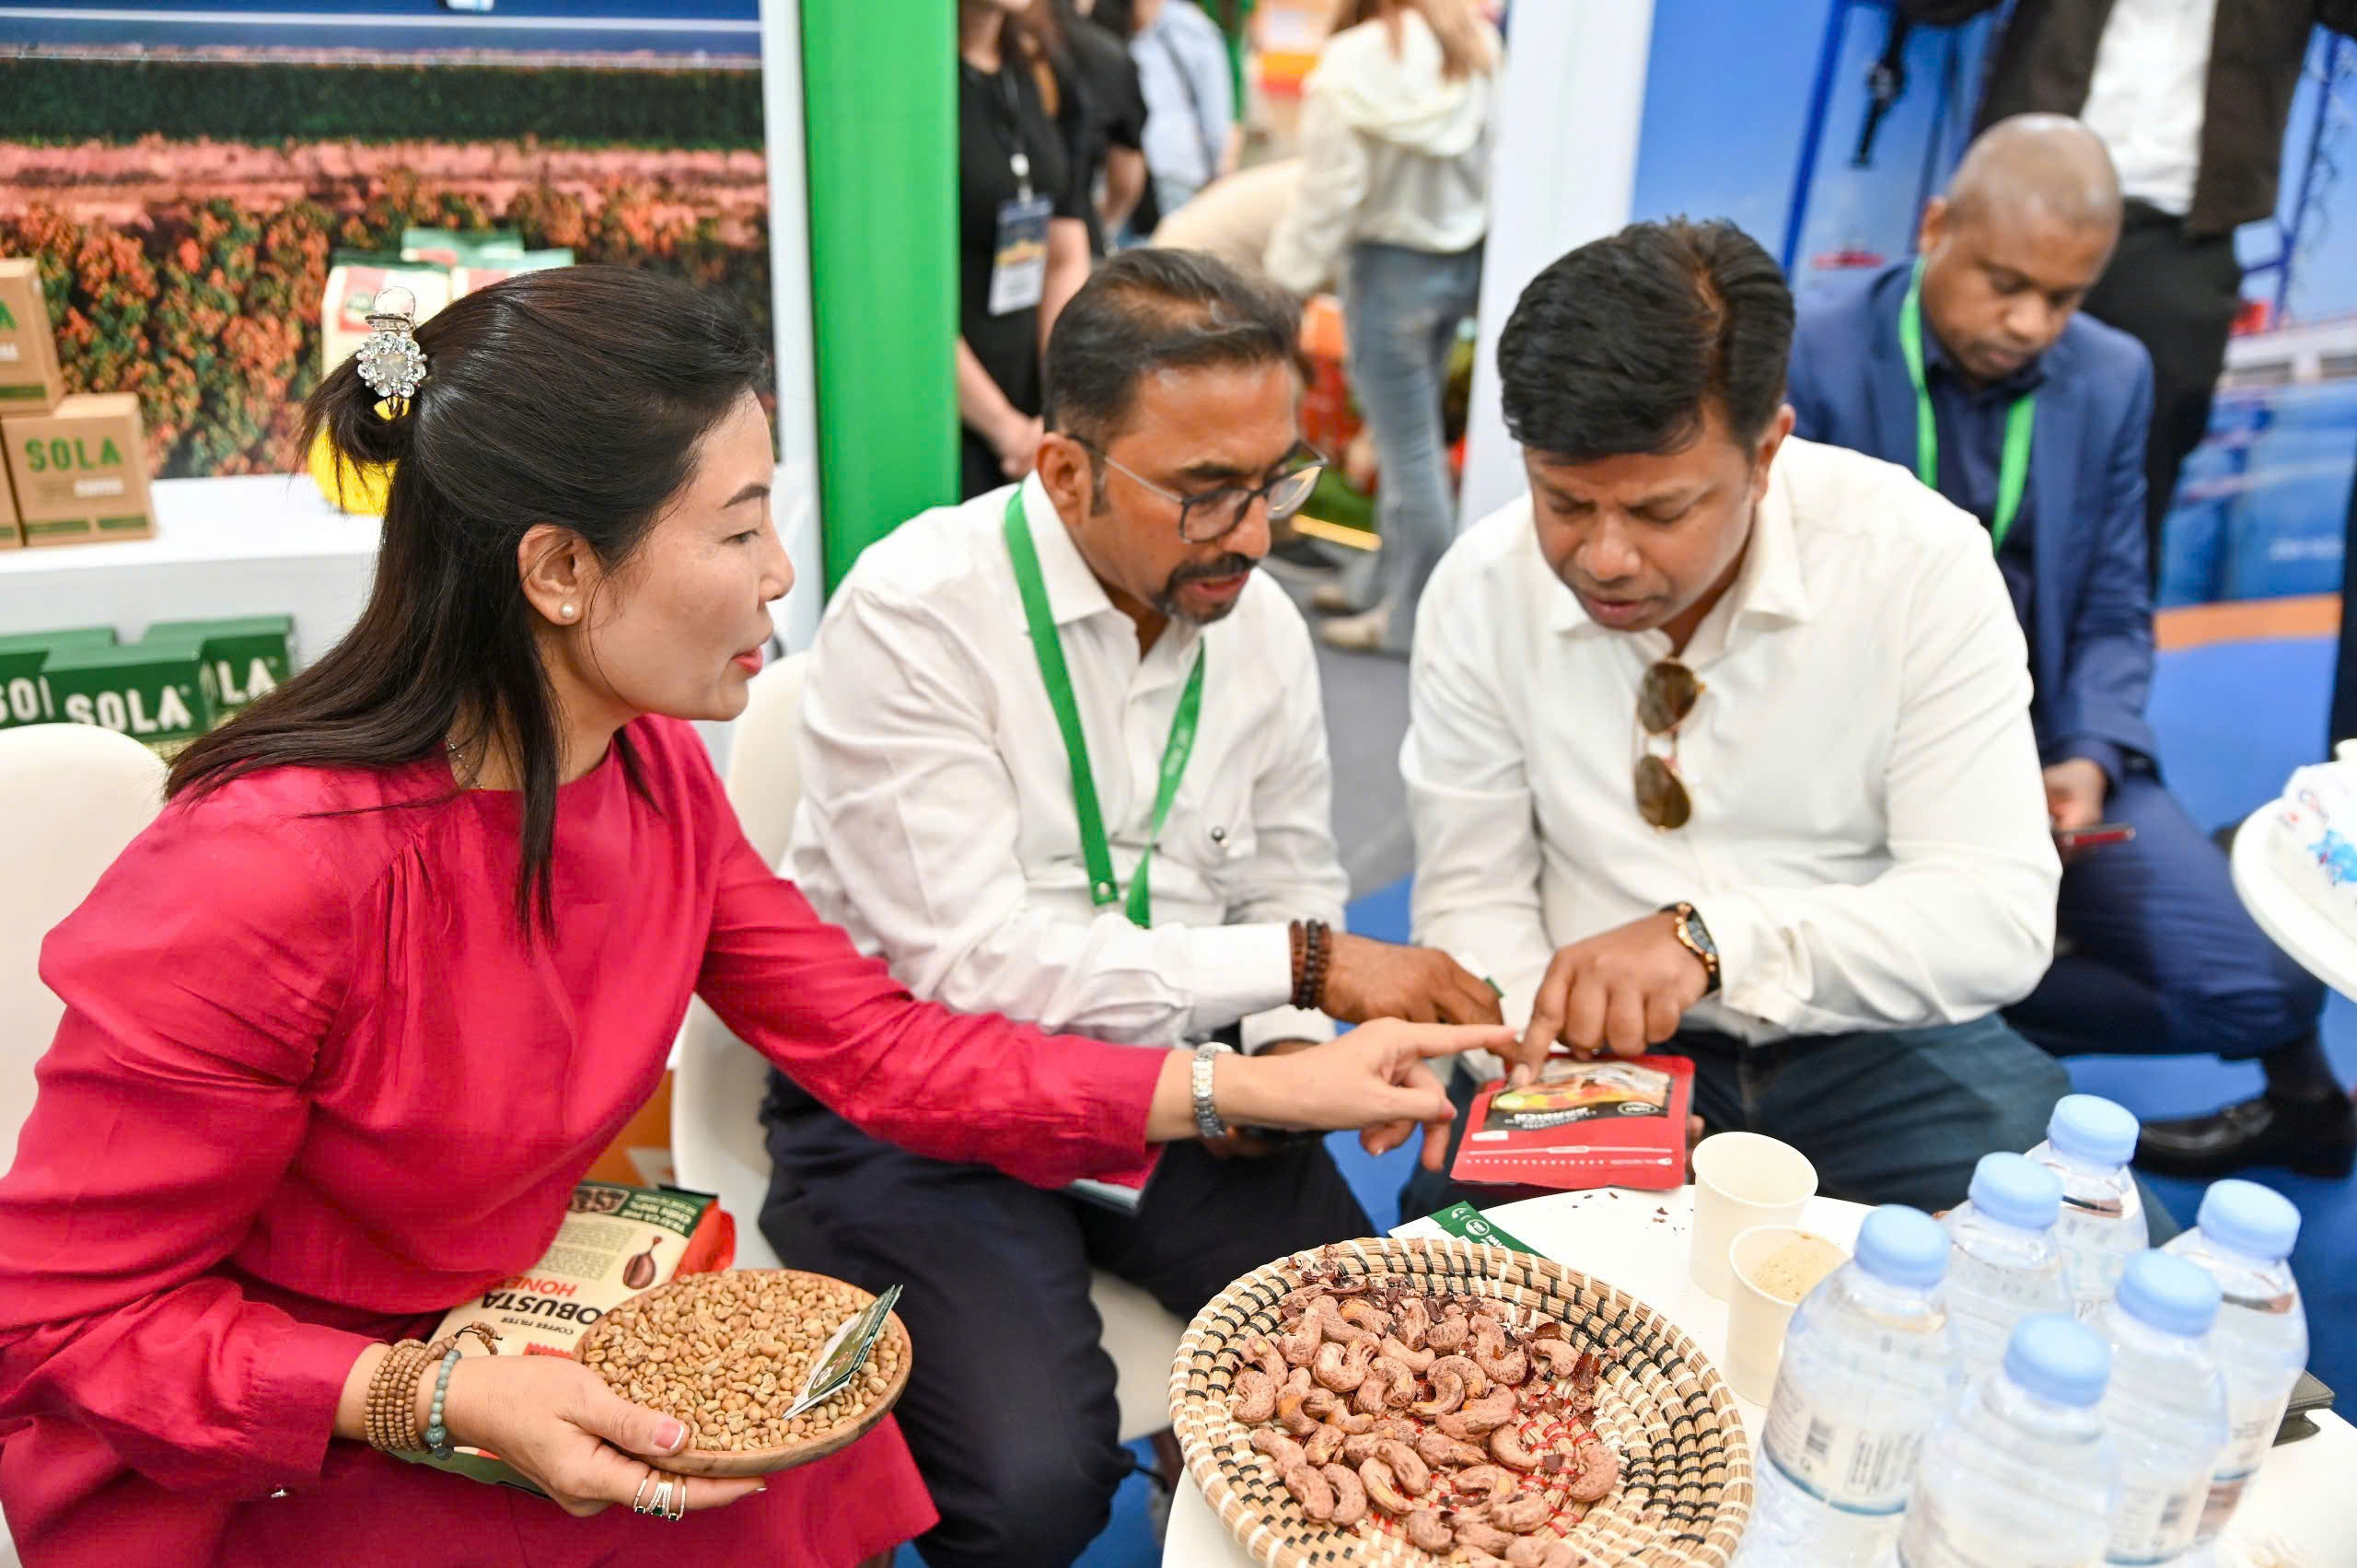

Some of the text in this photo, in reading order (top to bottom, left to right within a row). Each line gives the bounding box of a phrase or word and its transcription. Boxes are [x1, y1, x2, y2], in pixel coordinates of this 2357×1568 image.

[25, 436, 122, 471] SOLA
[65, 685, 192, 733] SOLA
[497, 1274, 578, 1297] HONE
[481, 1292, 603, 1325] OBUSTA
[501, 1317, 574, 1335] COFFEE FILTER
